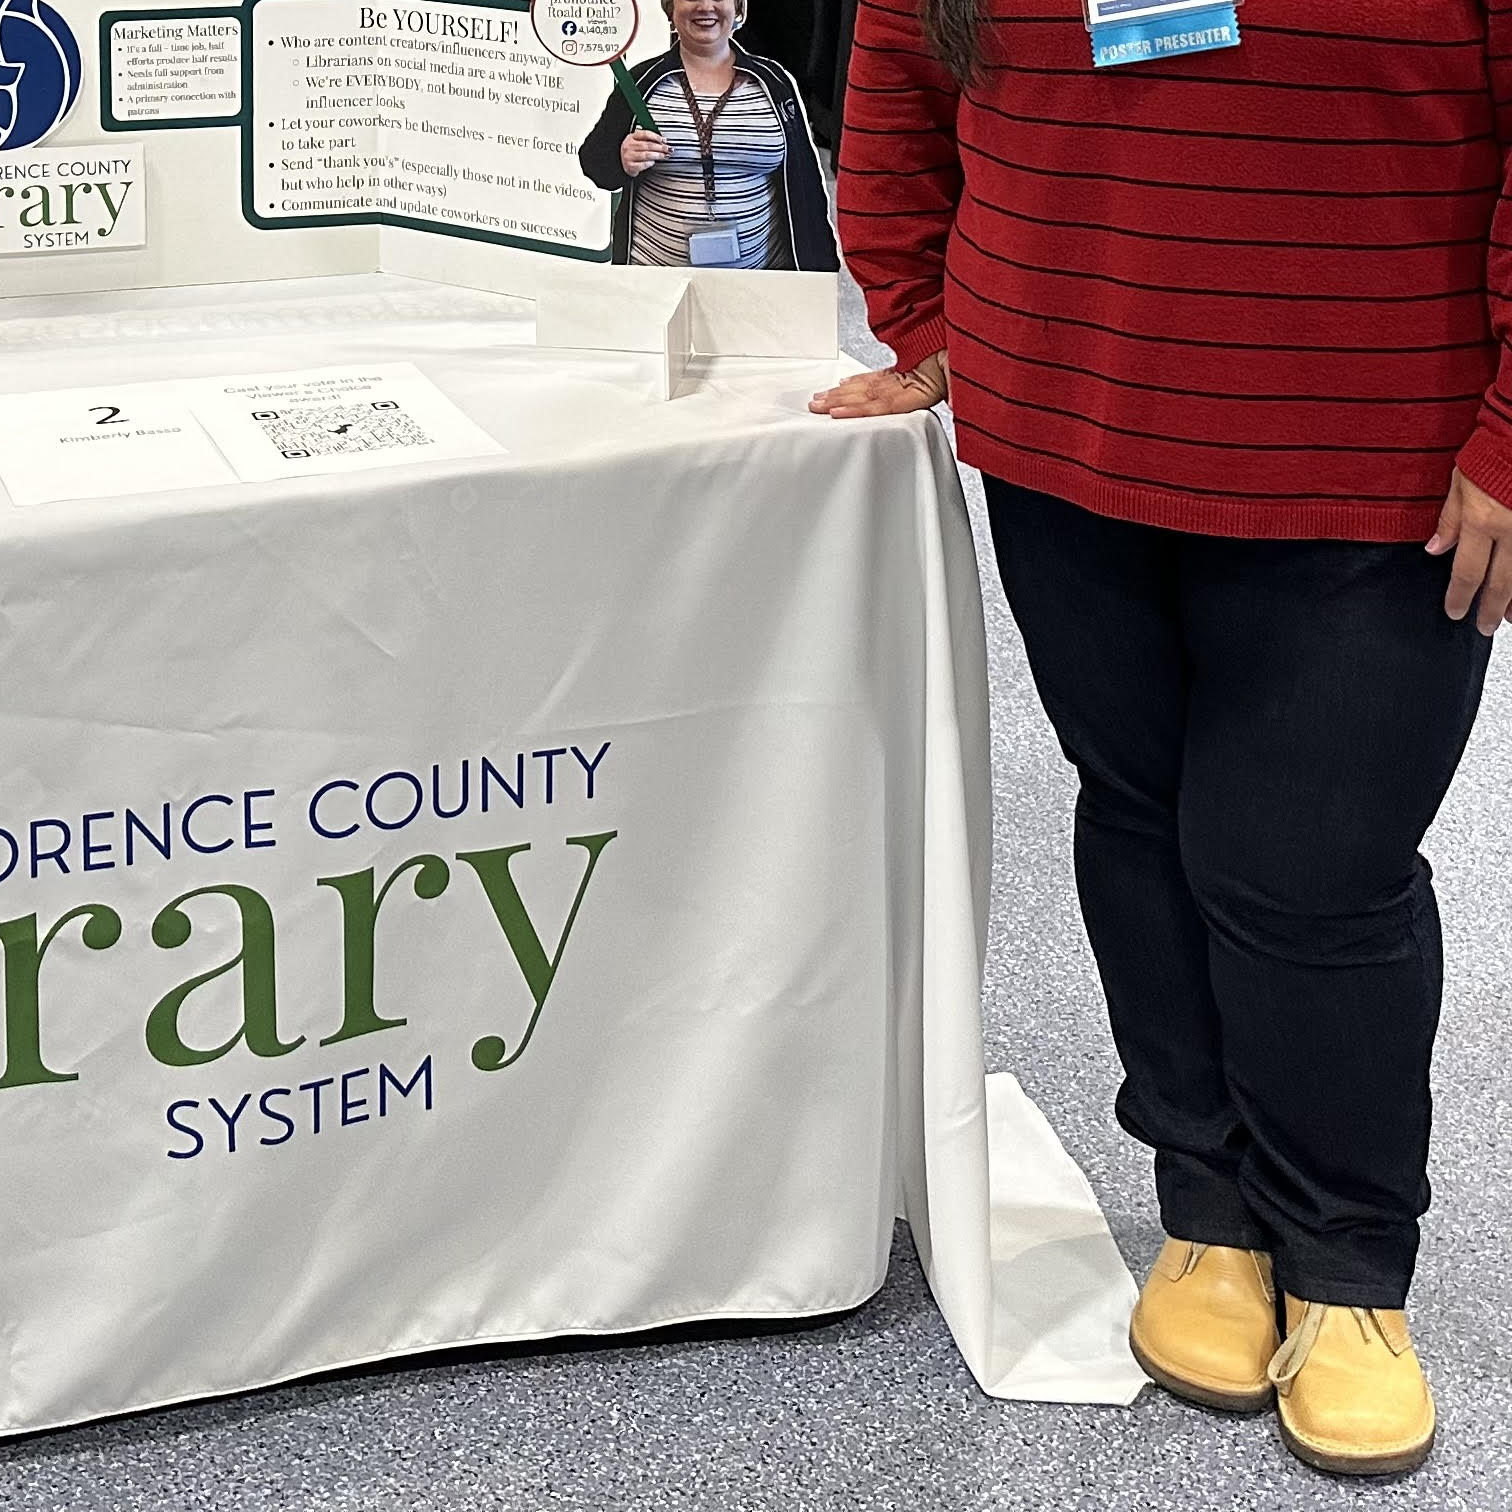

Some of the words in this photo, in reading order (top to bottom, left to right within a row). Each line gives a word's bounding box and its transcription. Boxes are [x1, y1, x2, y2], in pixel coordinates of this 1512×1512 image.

[548, 7, 582, 19] Roald
[586, 6, 621, 19] Dahl?
[114, 26, 184, 40] Marketing
[187, 24, 238, 37] Matters
[359, 7, 387, 29] Be
[393, 8, 518, 45] YOURSELF!
[1100, 40, 1152, 61] POSTER
[1154, 26, 1231, 52] PRESENTER
[306, 96, 374, 109] influencer
[375, 96, 406, 110] looks
[282, 140, 294, 151] to
[298, 137, 325, 150] take
[328, 137, 357, 151] part
[57, 159, 132, 177] COUNTY
[23, 231, 89, 249] SYSTEM
[223, 385, 260, 394] Cast
[264, 383, 297, 391] your
[318, 386, 372, 394] Choice
[88, 406, 129, 425] 2
[59, 432, 131, 444] Kimberly
[135, 427, 182, 436] Basso
[309, 741, 611, 839] COUNTY
[166, 1054, 432, 1159] SYSTEM
